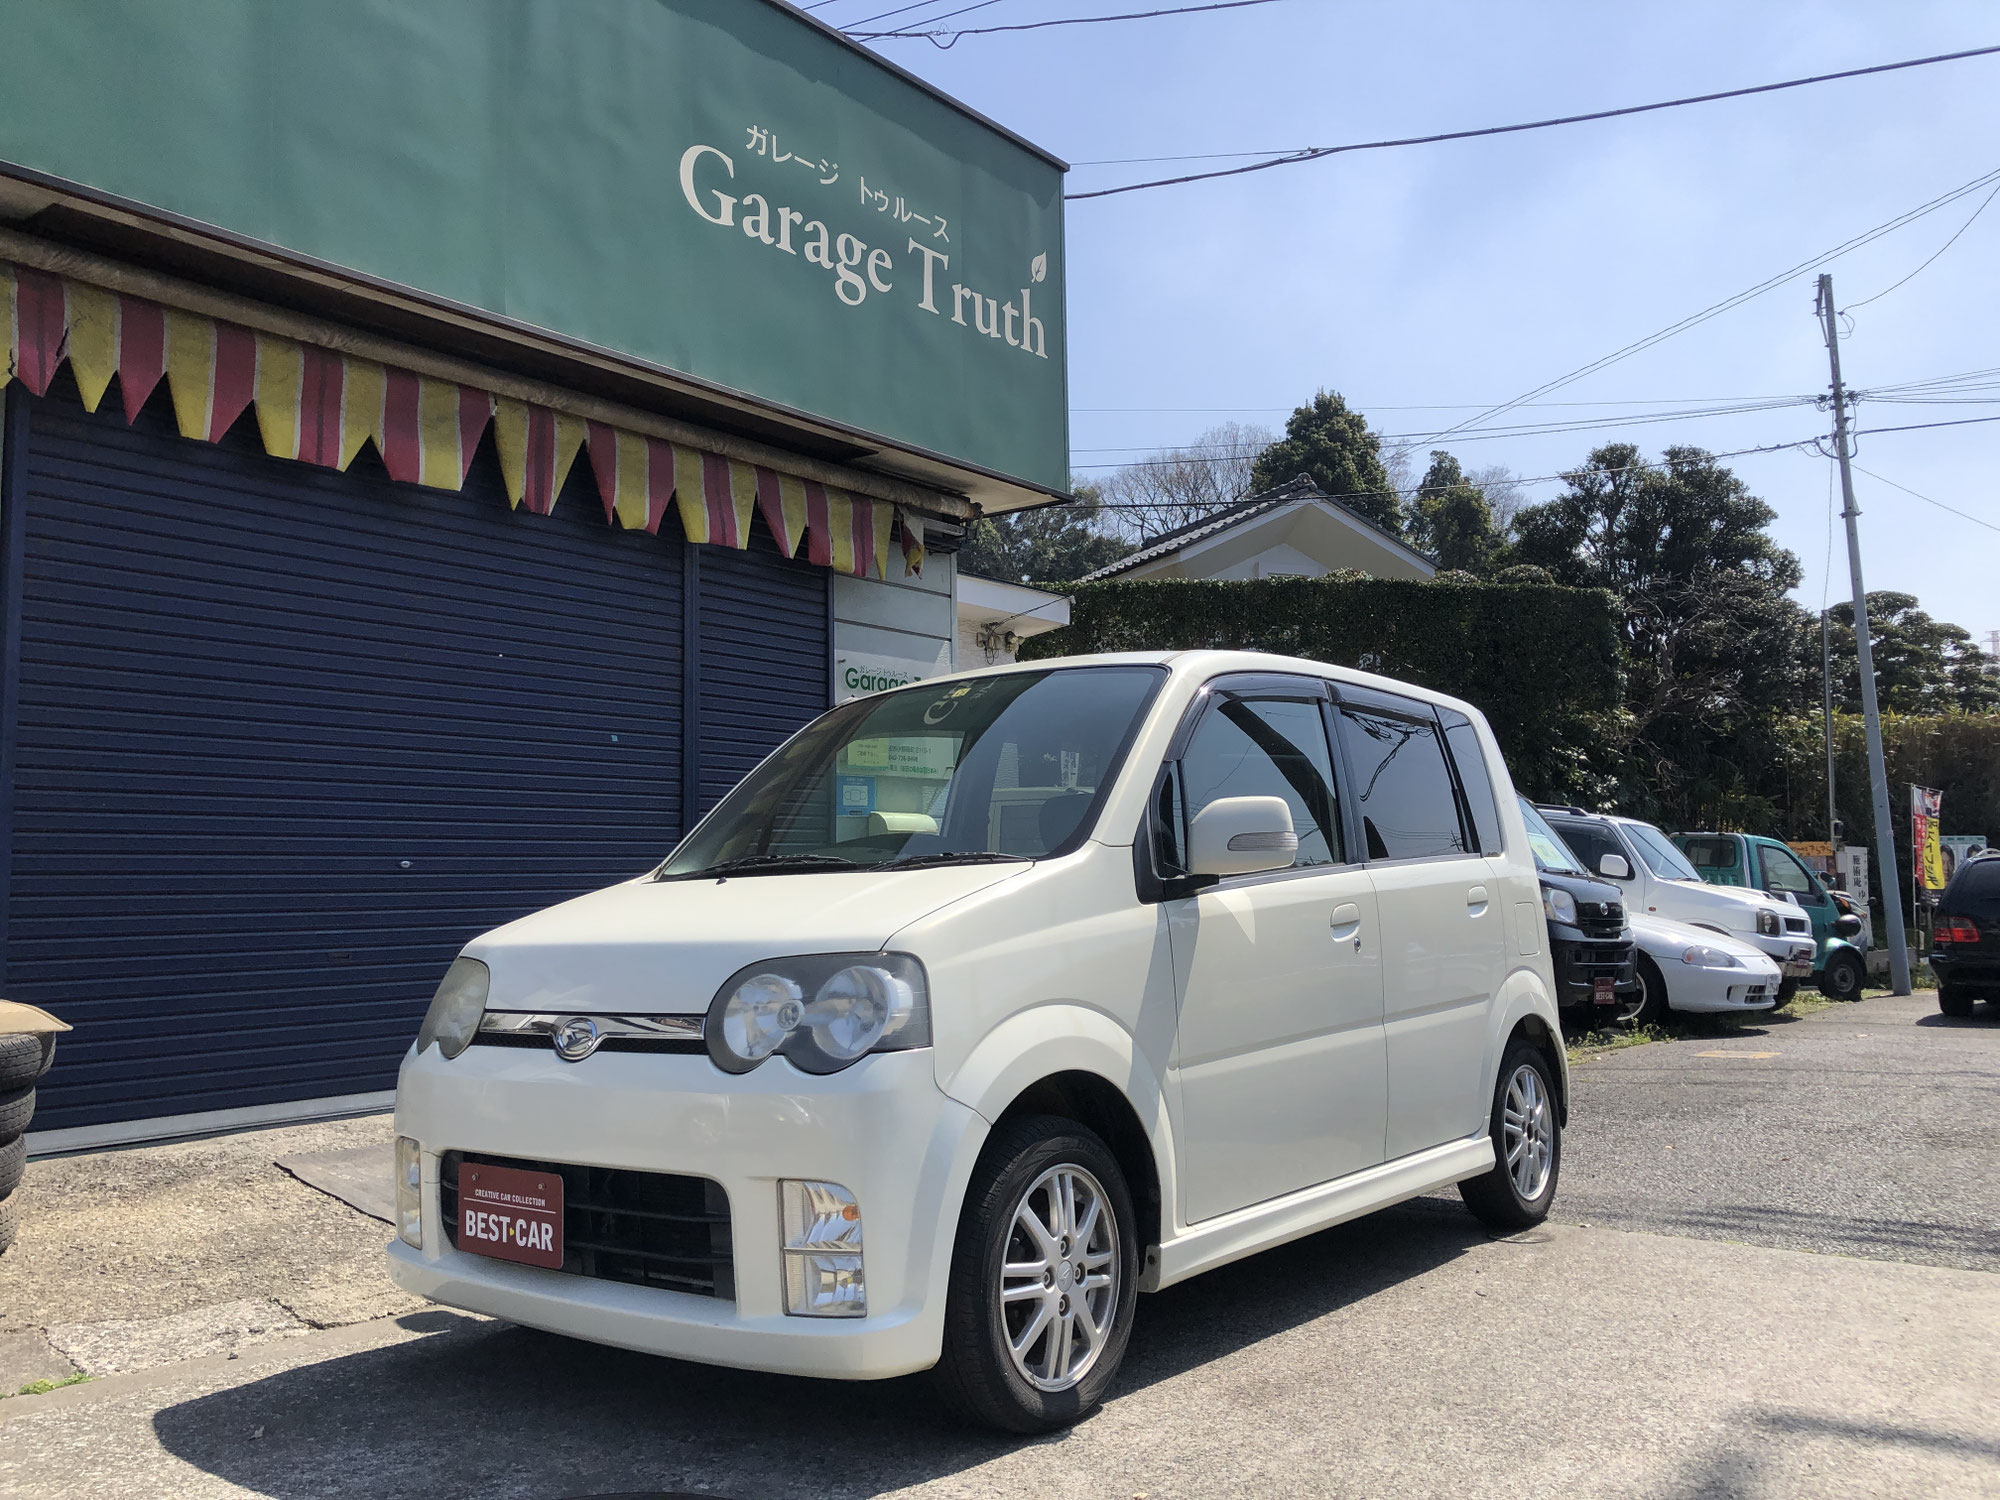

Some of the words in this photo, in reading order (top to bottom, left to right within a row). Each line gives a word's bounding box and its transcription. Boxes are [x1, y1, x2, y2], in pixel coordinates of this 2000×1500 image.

[745, 124, 839, 185] ガレージ
[859, 176, 951, 242] トゥルース
[679, 144, 893, 306] Garage
[907, 237, 1048, 359] Truth
[465, 1209, 510, 1243] BEST
[515, 1218, 553, 1252] CAR
[474, 1188, 499, 1200] CREATIVE
[500, 1192, 511, 1202] CAR
[512, 1194, 546, 1207] COLLECTION
